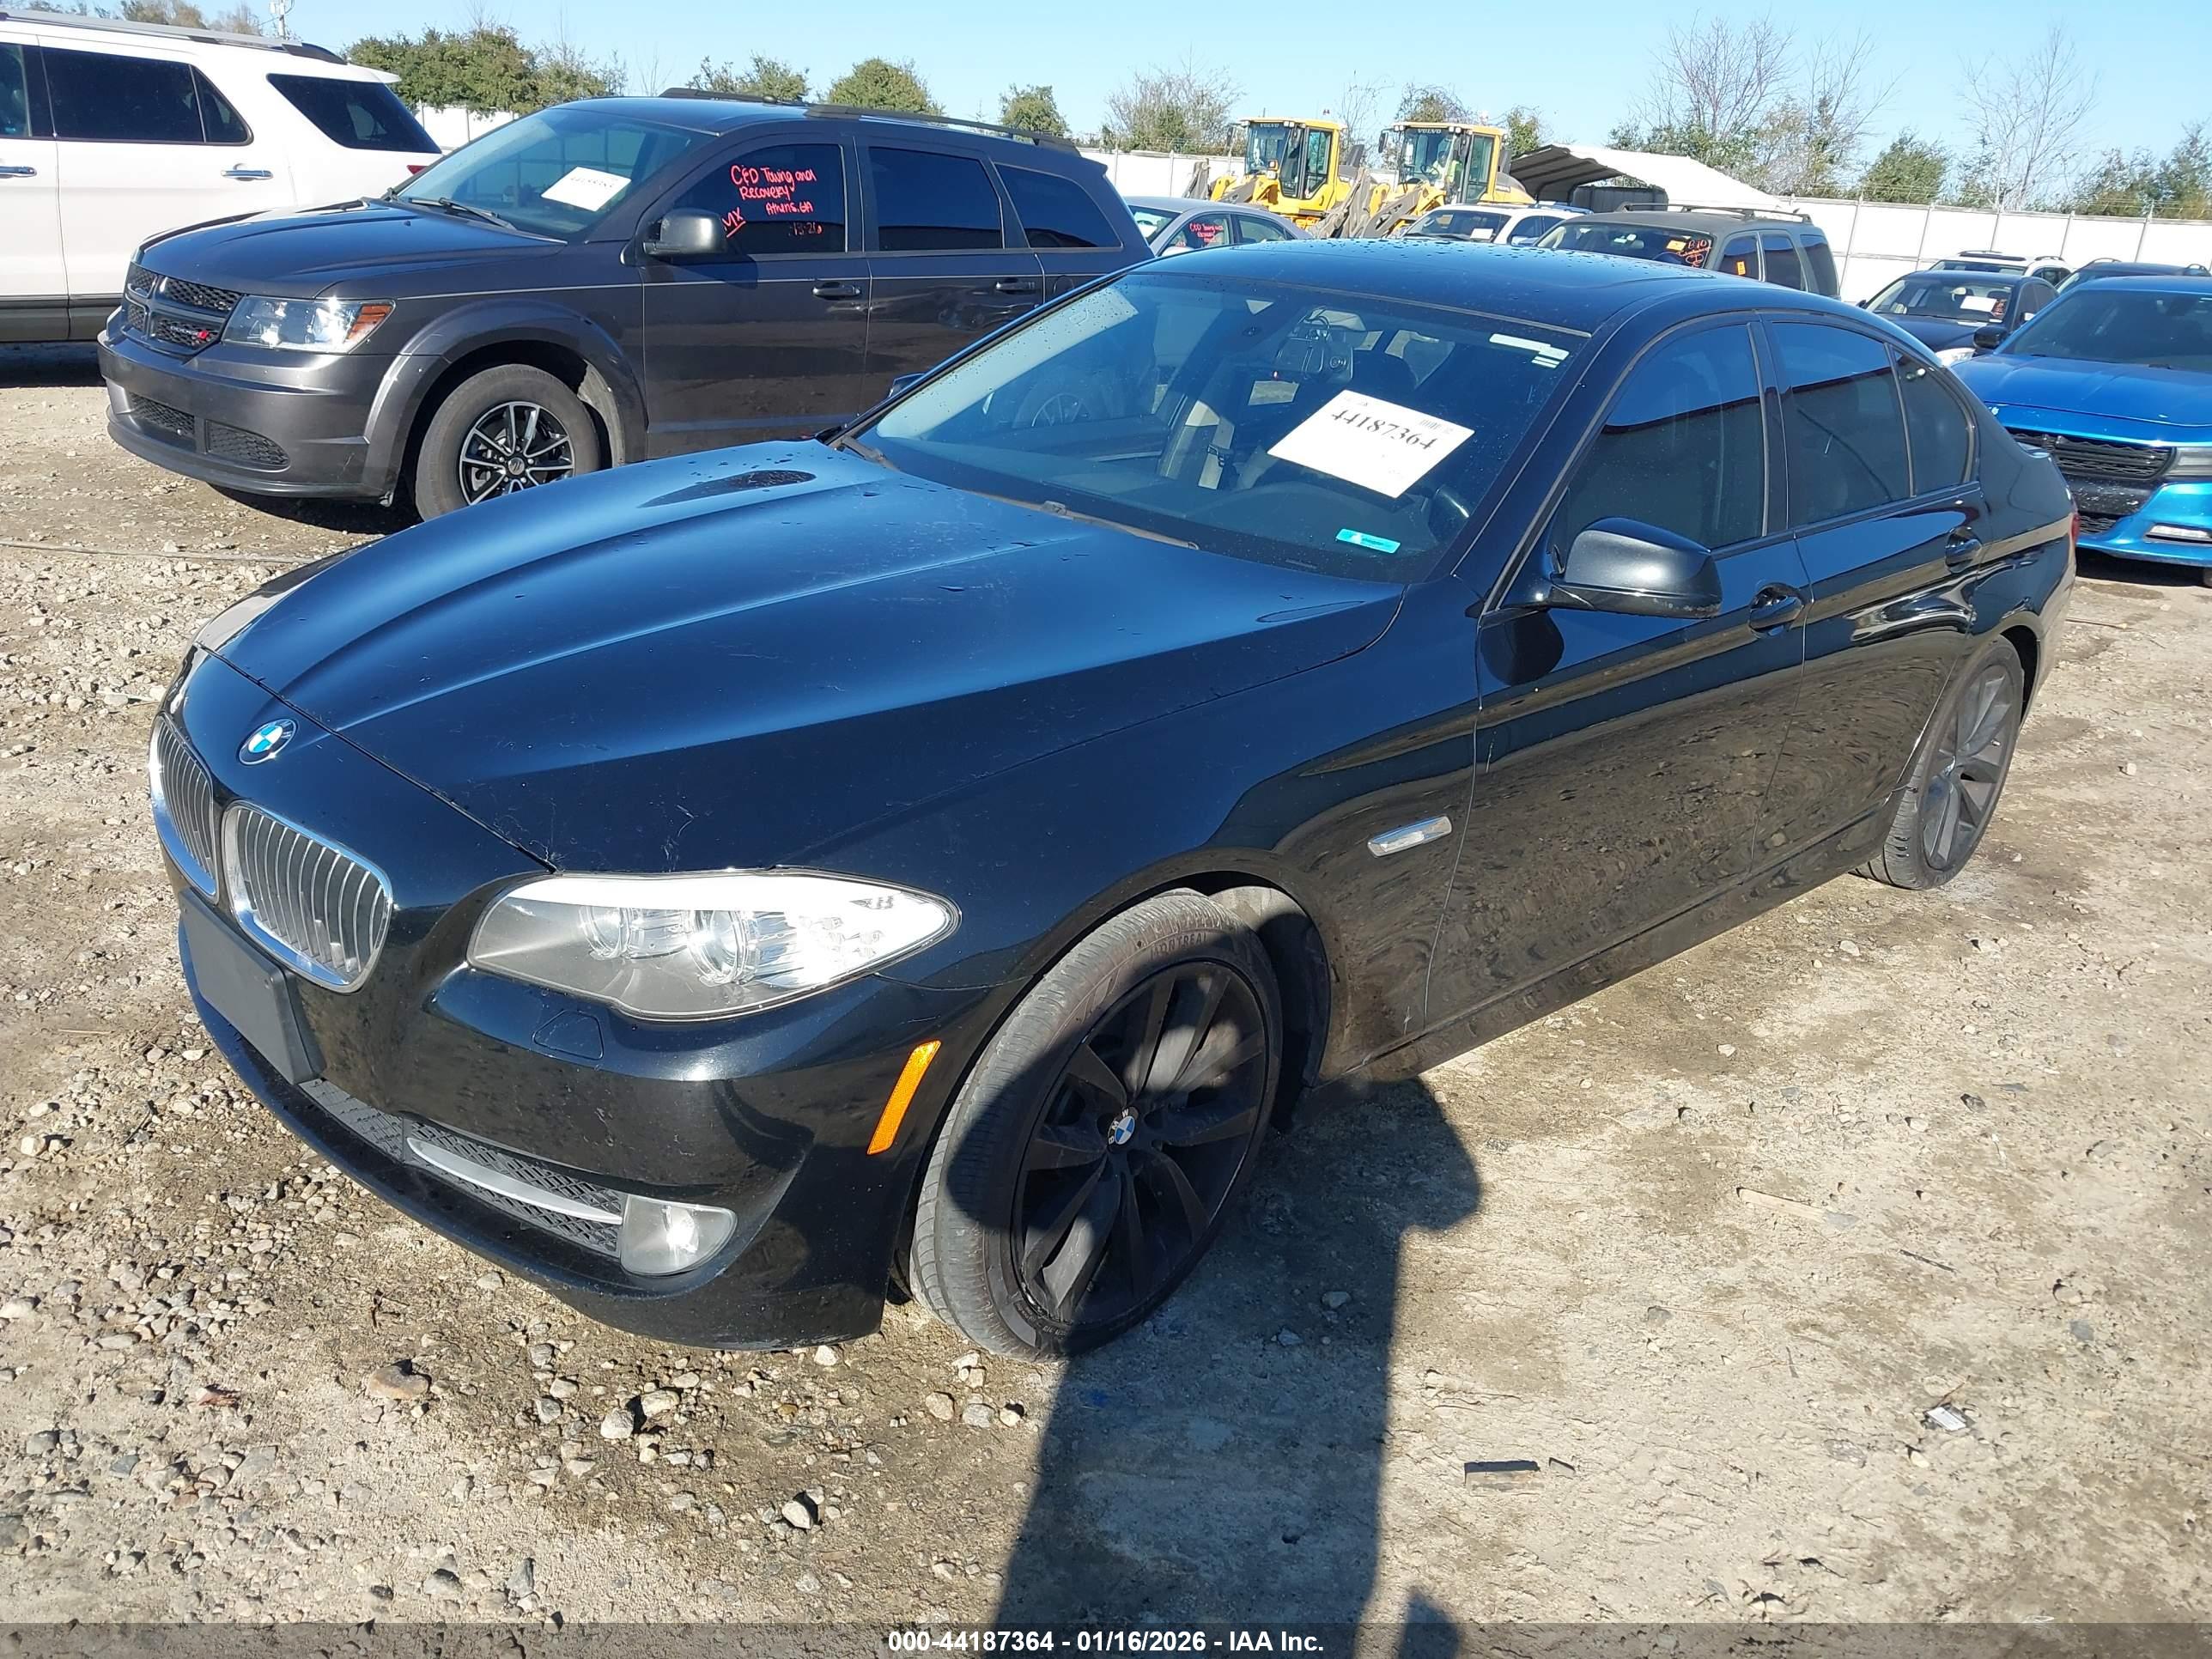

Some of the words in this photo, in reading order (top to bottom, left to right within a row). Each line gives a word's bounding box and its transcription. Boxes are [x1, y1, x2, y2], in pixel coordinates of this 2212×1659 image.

[760, 167, 795, 192] Towing
[795, 168, 817, 181] and
[1331, 409, 1438, 450] 44187364
[1108, 1108, 1129, 1146] BMW
